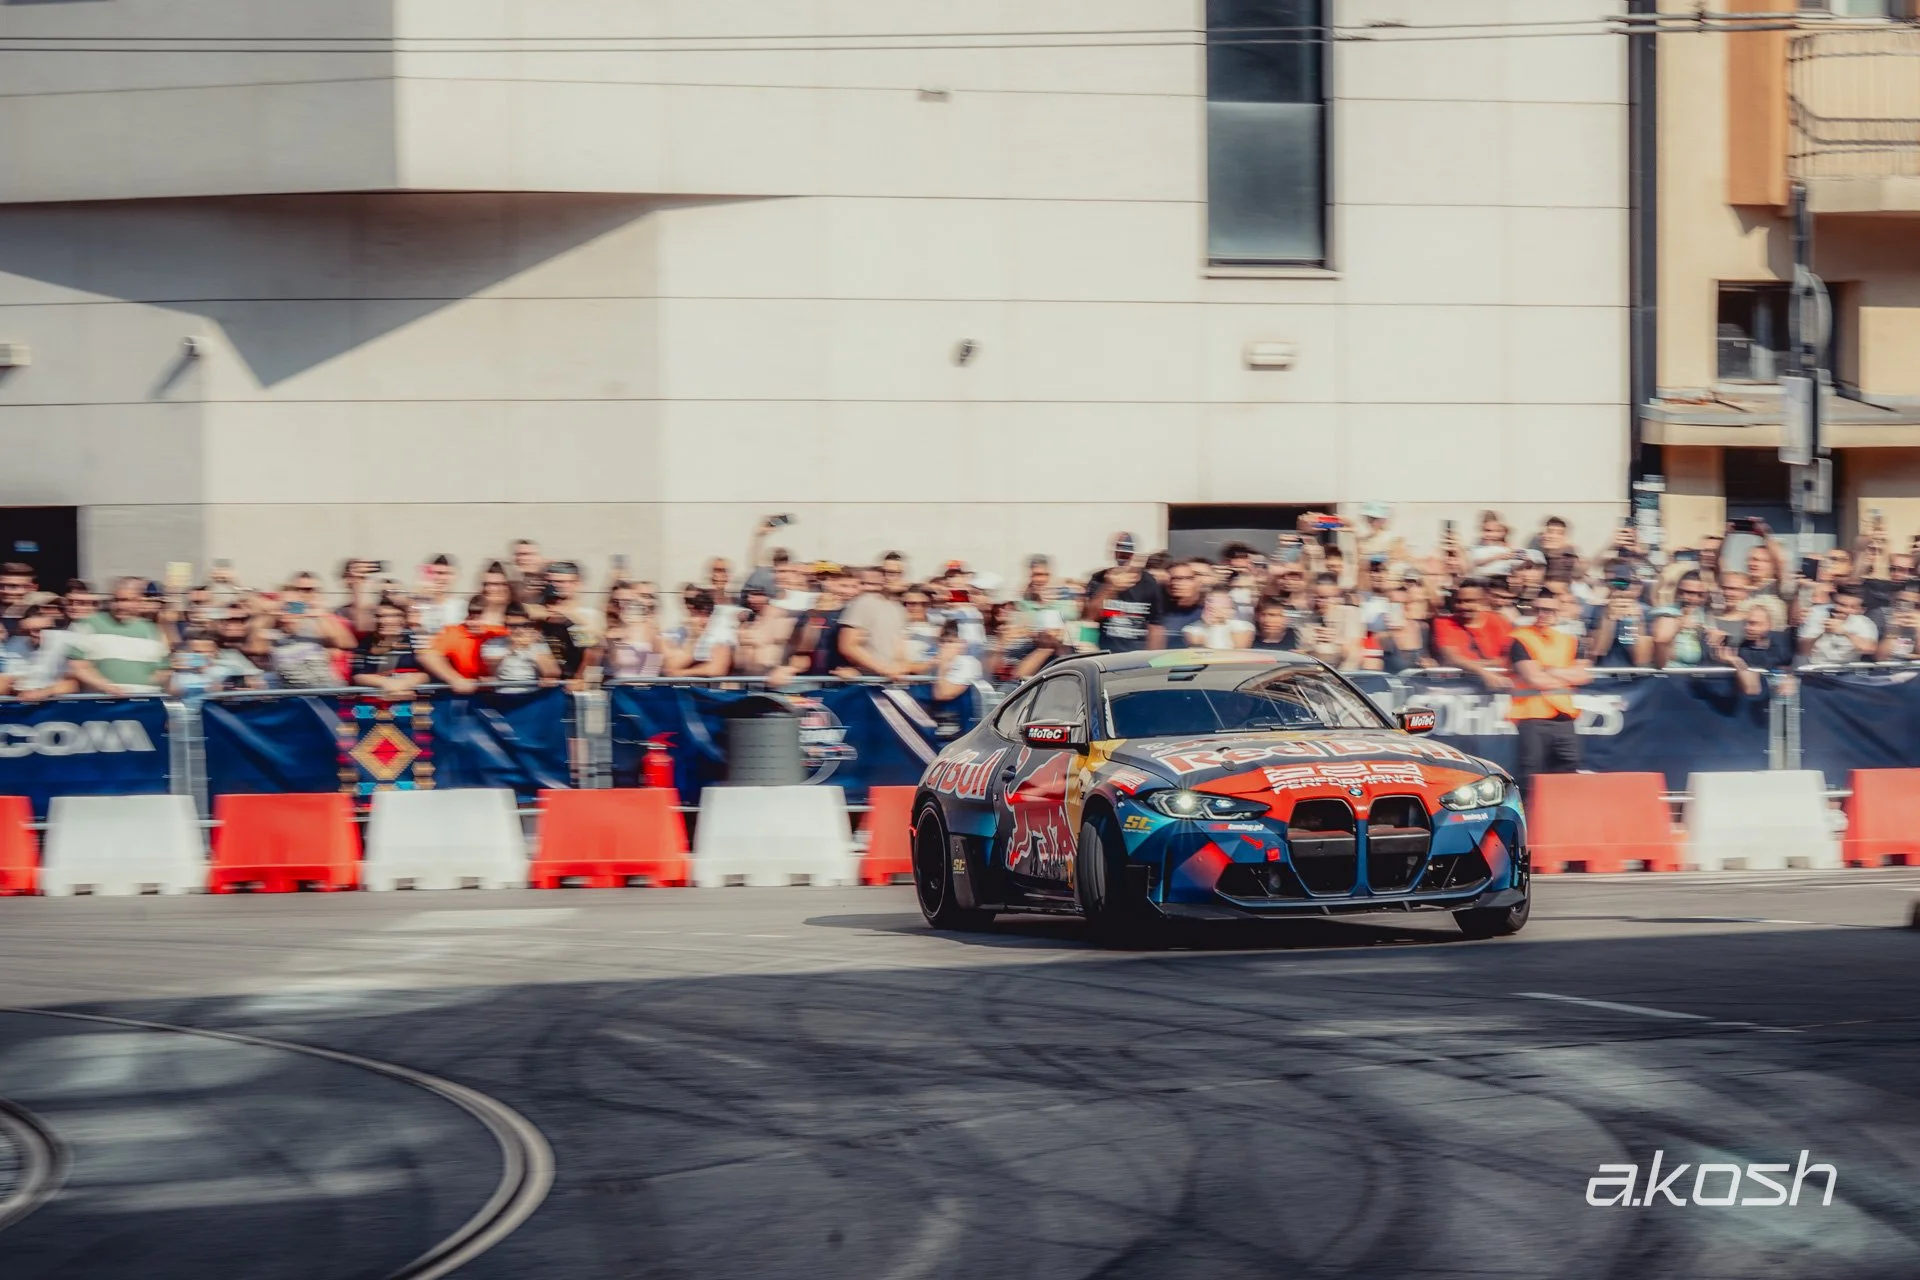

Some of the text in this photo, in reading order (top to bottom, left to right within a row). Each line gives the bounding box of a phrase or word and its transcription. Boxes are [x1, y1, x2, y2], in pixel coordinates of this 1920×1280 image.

[1028, 727, 1062, 739] MoTeC
[1156, 741, 1329, 775] Red
[1321, 740, 1473, 764] Bull
[1271, 775, 1428, 795] PERFORMANCE
